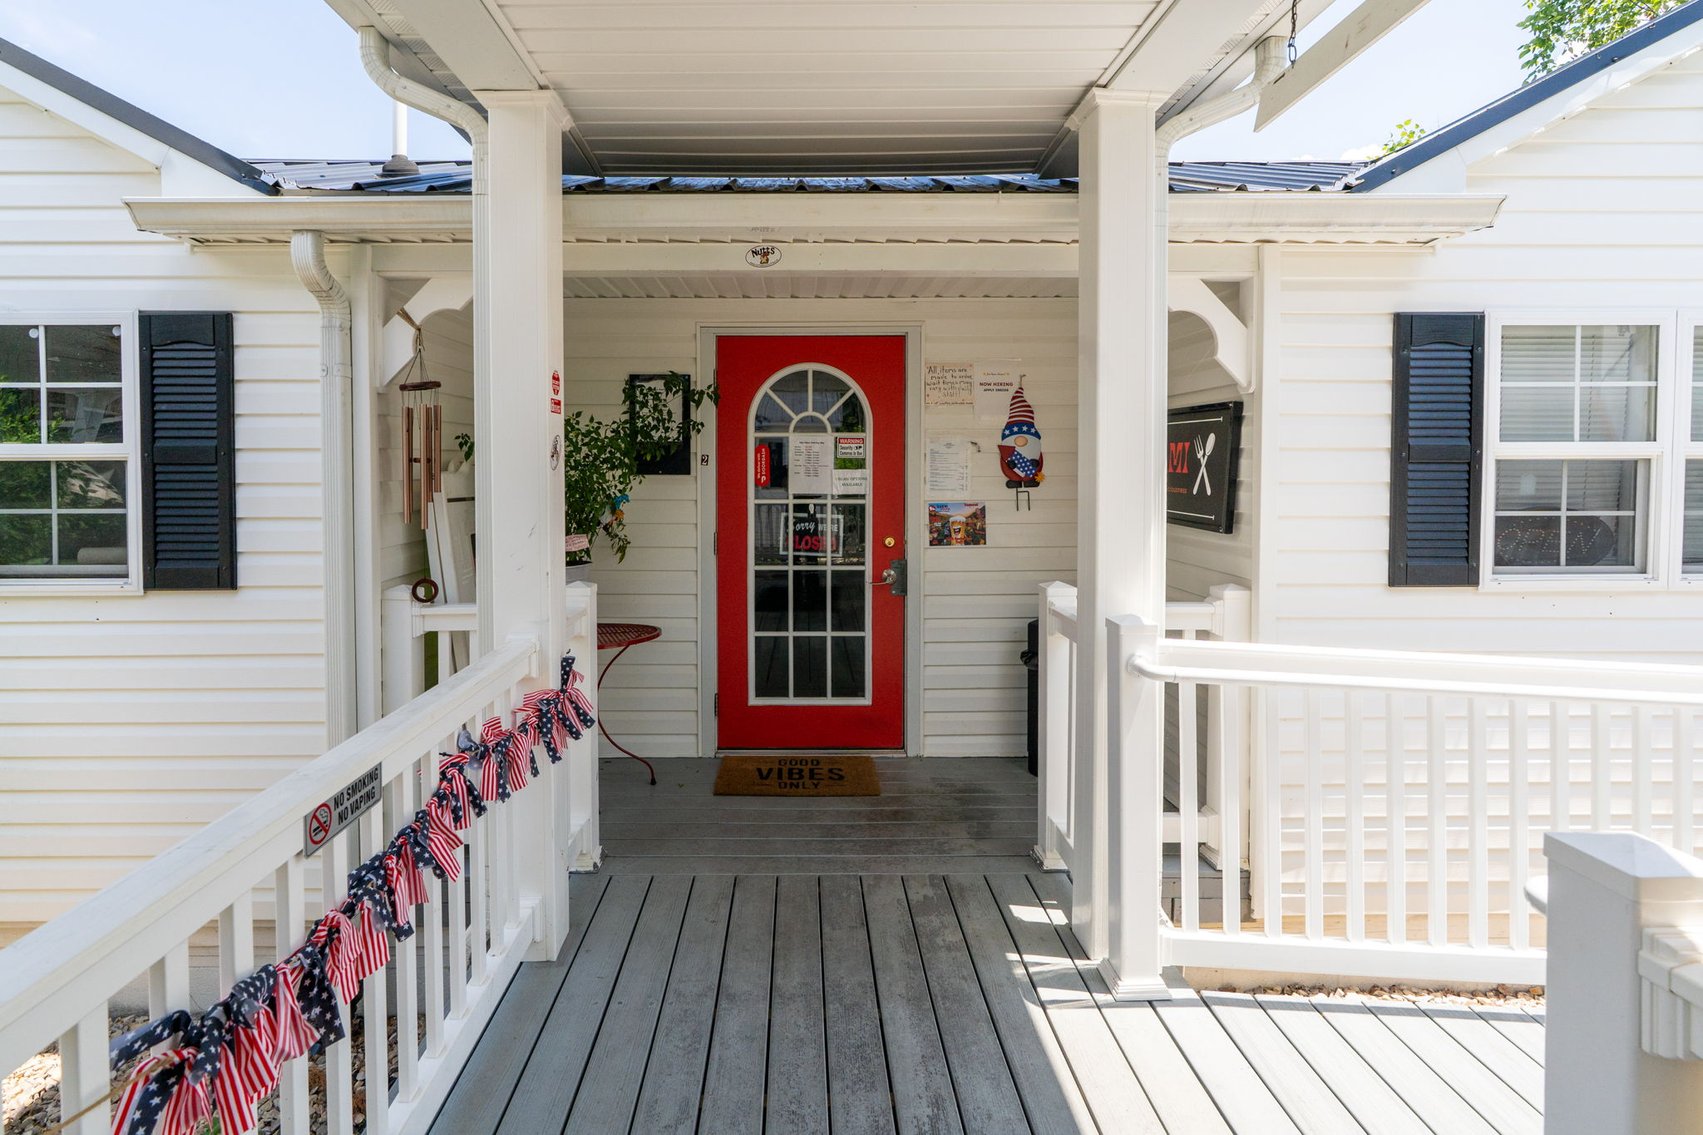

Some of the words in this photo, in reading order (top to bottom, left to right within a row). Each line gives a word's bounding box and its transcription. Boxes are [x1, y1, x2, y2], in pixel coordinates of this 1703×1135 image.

[702, 455, 708, 466] 2
[778, 758, 821, 767] GOOD
[756, 767, 846, 781] VIBES
[333, 792, 345, 811] NO
[346, 767, 379, 802] SMOKING
[778, 781, 821, 789] ONLY
[338, 806, 349, 826] NO
[350, 786, 376, 816] VAPING
